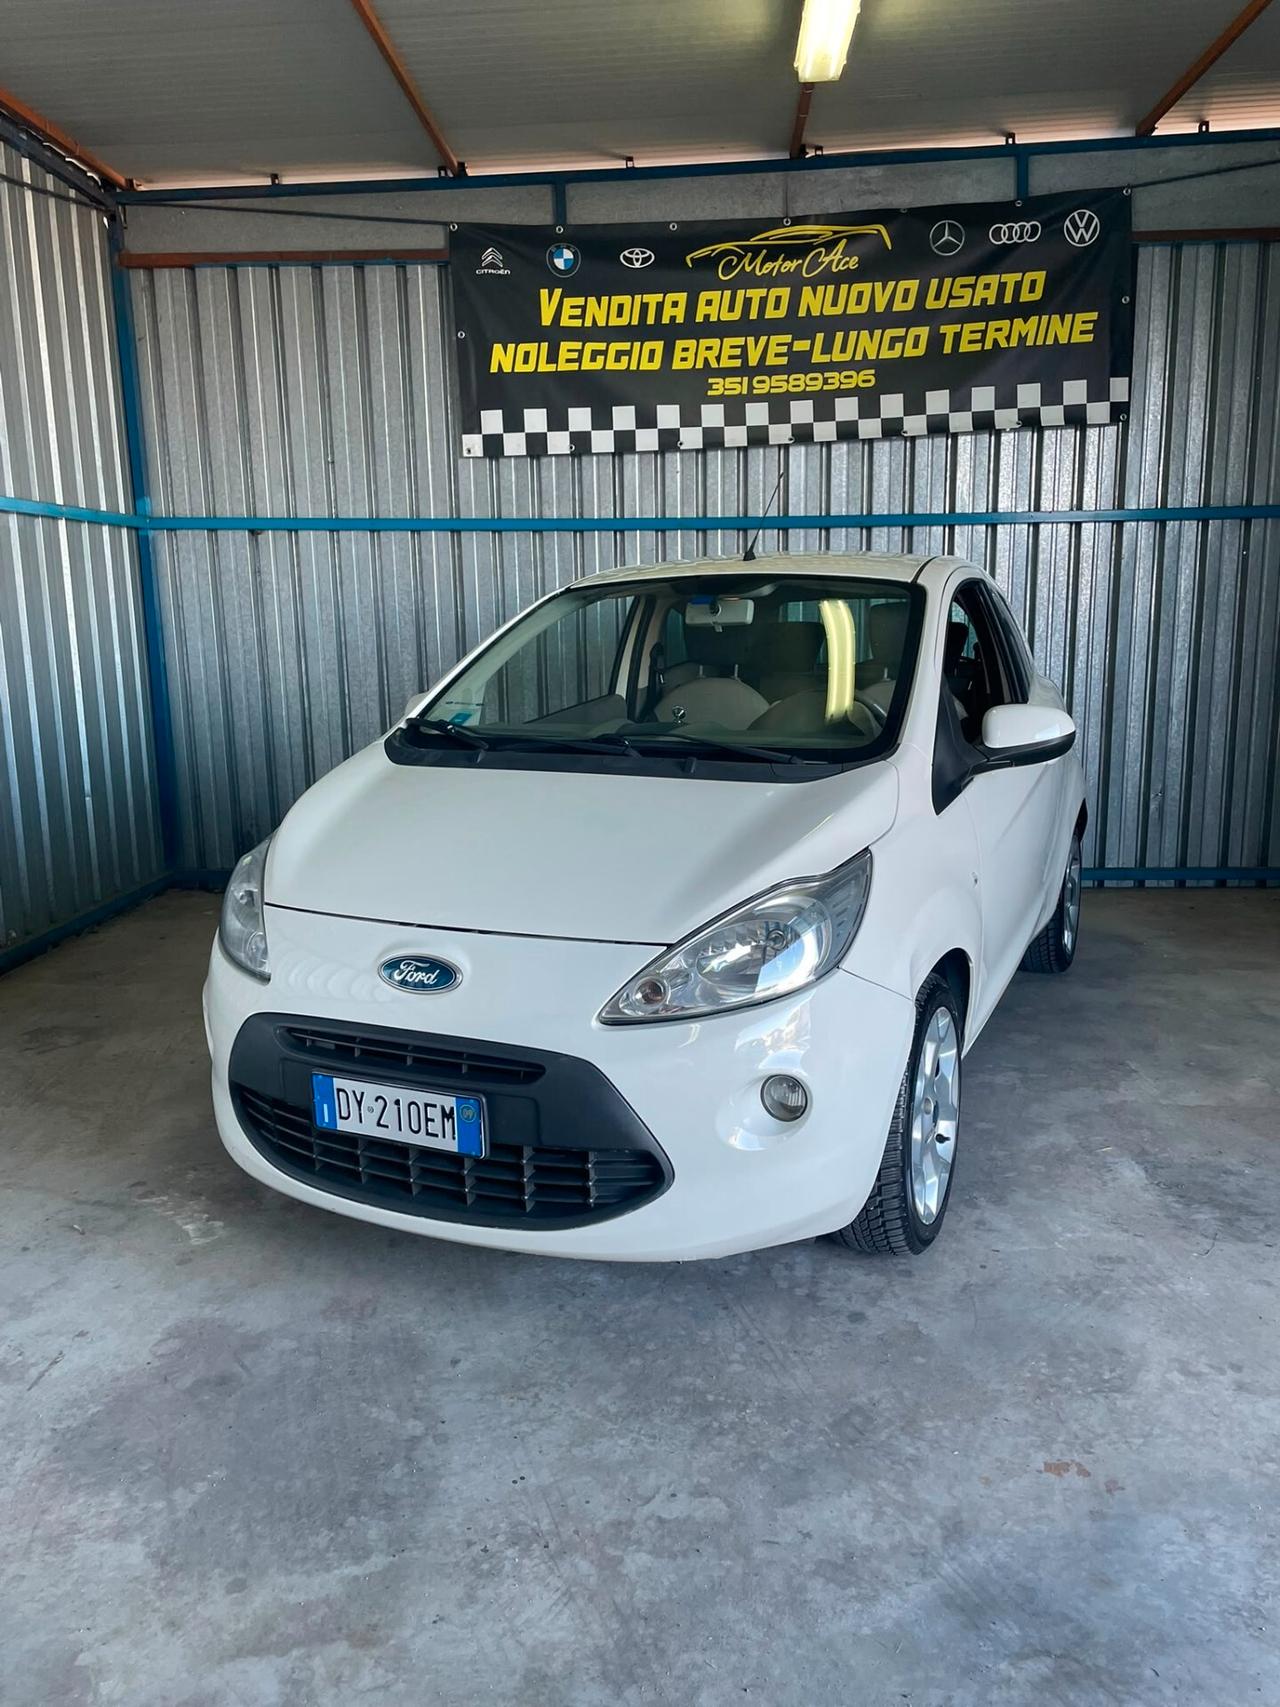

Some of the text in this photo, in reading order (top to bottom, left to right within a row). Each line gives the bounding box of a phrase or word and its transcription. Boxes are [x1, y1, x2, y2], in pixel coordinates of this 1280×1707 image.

[718, 238, 859, 281] Motor Ace
[540, 270, 1047, 328] VENDITA AUTO NUOVO USATO
[489, 311, 1098, 373] NOLEGGIO BREVE-LUNGO TERMINE
[707, 369, 876, 396] 351 9589396
[394, 960, 440, 985] Ford
